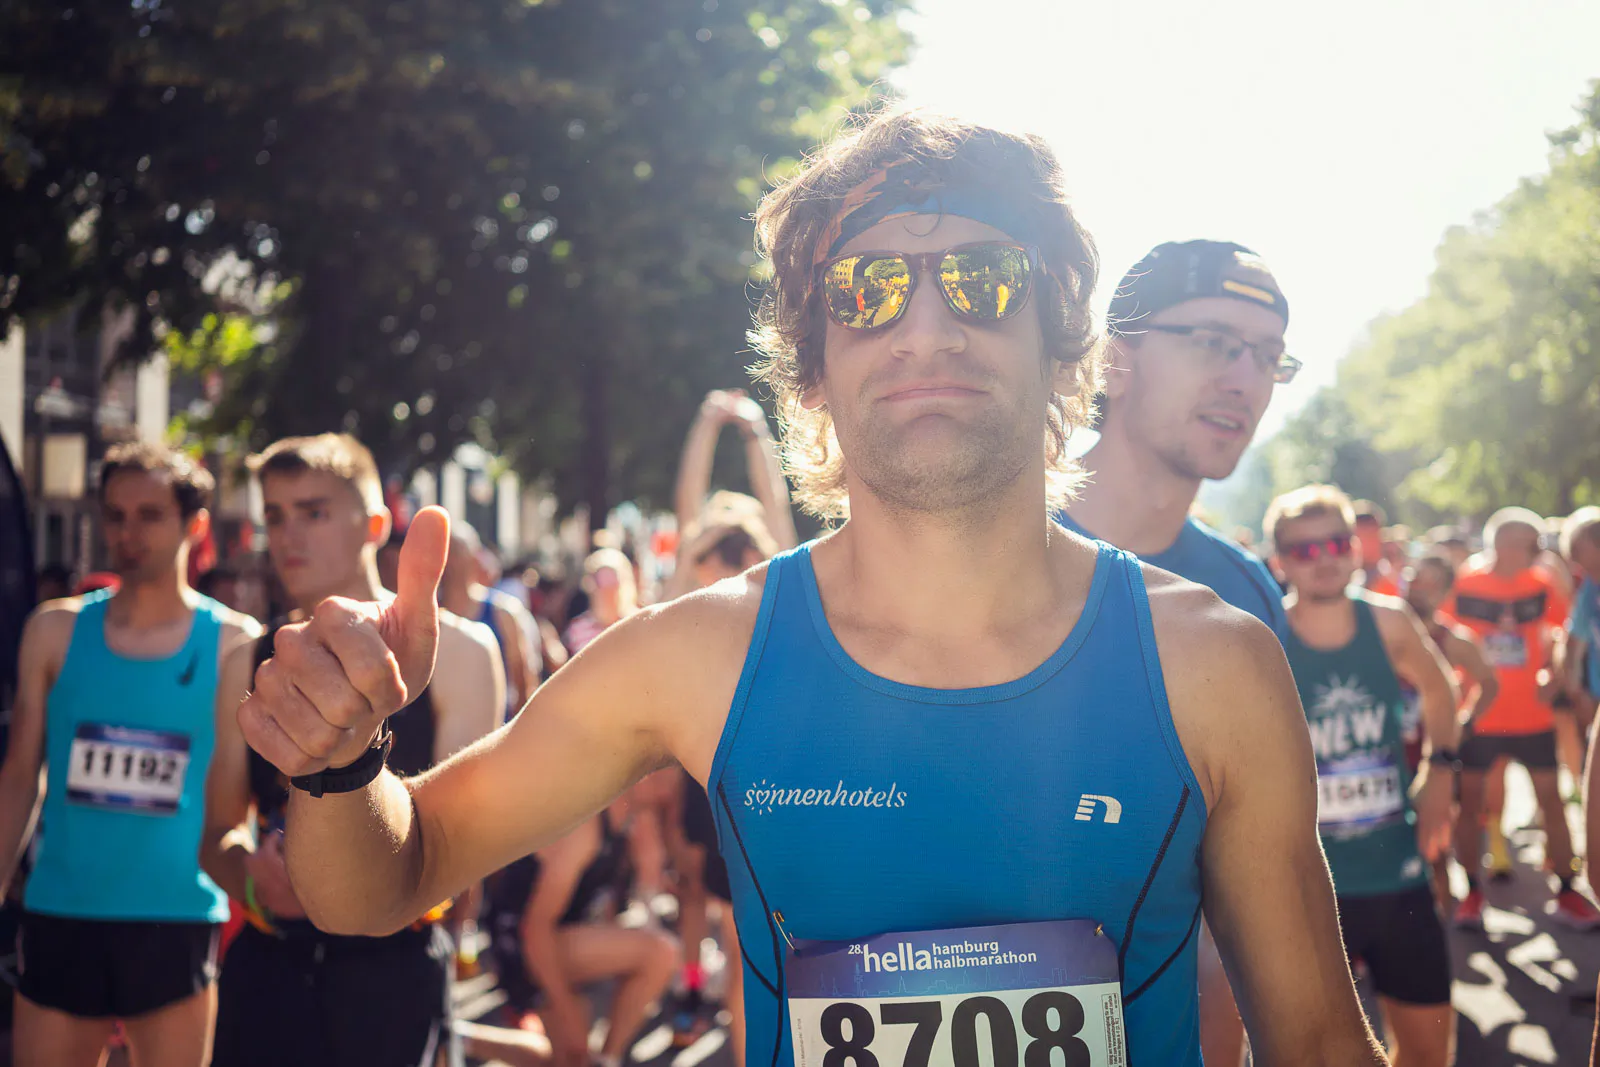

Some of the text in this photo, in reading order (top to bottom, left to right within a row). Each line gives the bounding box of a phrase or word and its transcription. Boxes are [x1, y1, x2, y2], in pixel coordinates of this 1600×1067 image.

[1310, 702, 1386, 759] NEW
[83, 745, 178, 784] 11192
[744, 779, 908, 811] sonnenhotels
[848, 940, 999, 973] 28. hella hamburg
[933, 950, 1037, 970] halbmarathon
[820, 991, 1091, 1067] 8708
